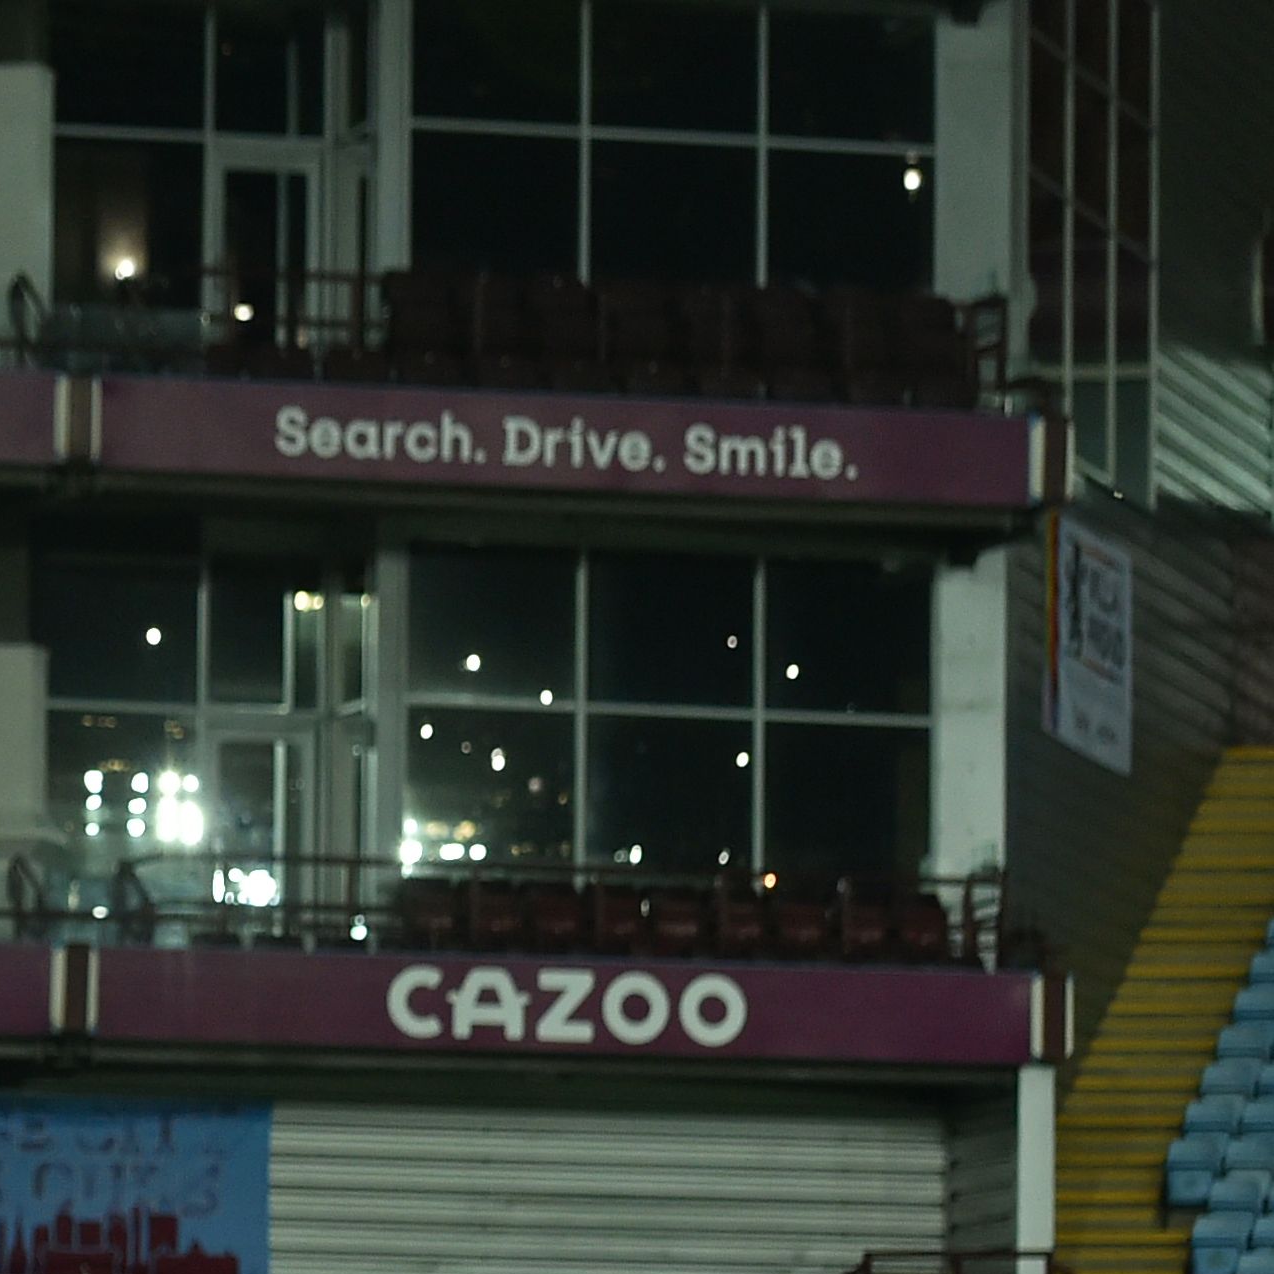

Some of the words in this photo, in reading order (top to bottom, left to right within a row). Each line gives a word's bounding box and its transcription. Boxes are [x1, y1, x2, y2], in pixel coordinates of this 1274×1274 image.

[274, 404, 487, 465] Search.
[502, 415, 667, 474] Drive.
[683, 422, 858, 482] Smile.
[386, 964, 748, 1048] CAZOO
